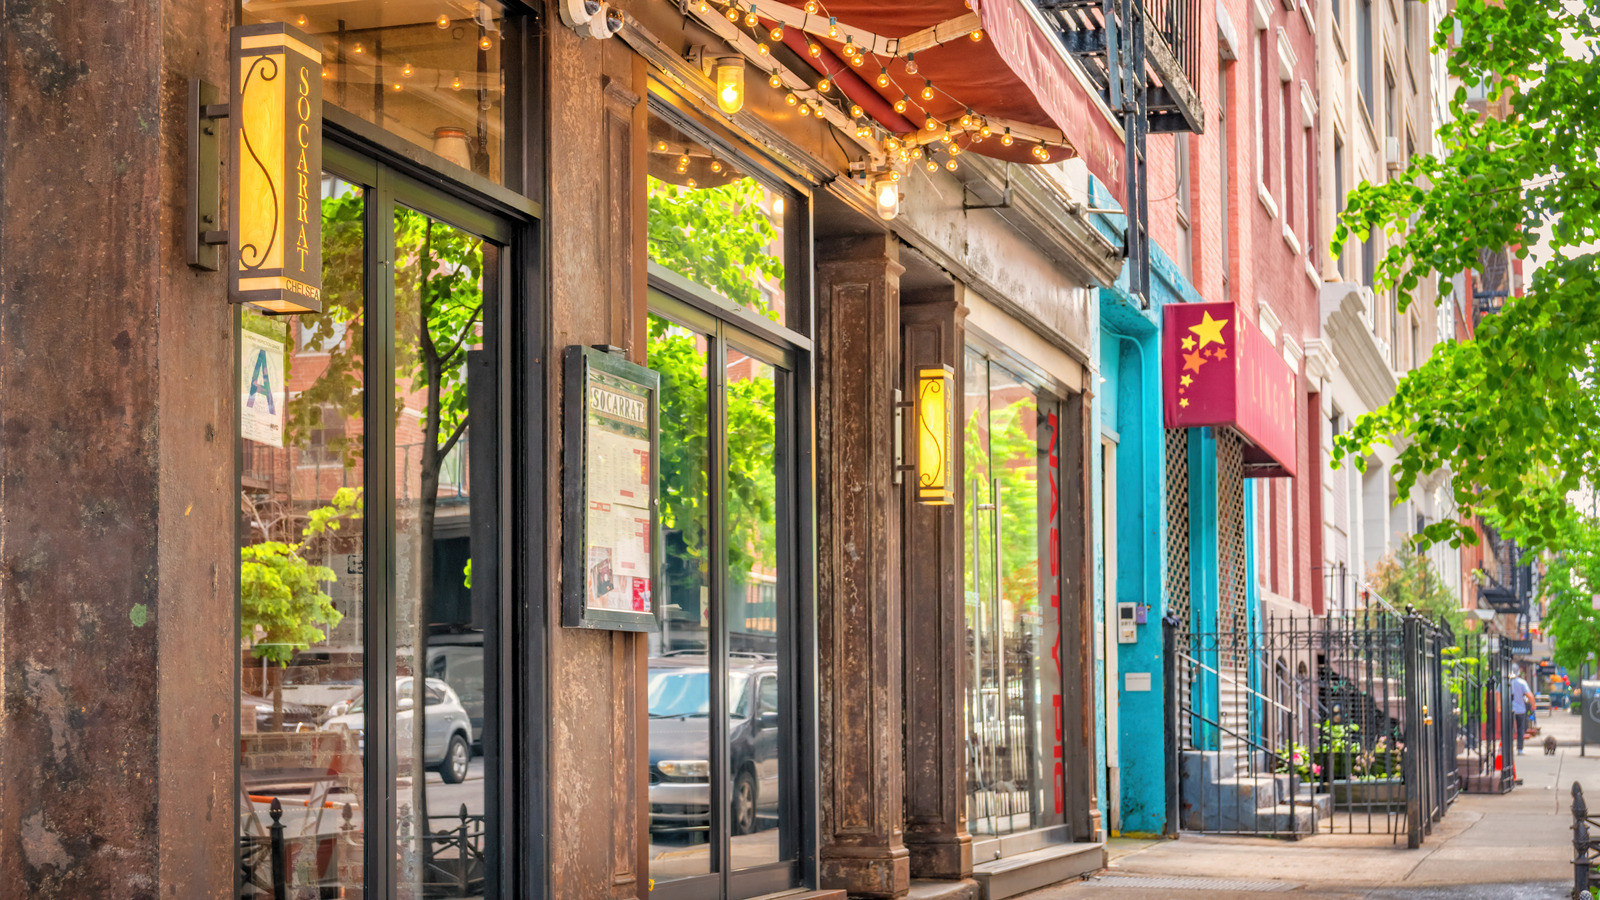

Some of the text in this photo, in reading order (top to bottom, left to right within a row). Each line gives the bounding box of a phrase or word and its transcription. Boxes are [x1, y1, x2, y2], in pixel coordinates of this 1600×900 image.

[297, 66, 310, 272] SOCARRAT
[286, 279, 319, 301] CHELSEA
[246, 349, 276, 416] A
[592, 389, 643, 421] SOCARRAT
[1250, 359, 1286, 431] LINGO
[1048, 412, 1064, 814] NASTY PIG
